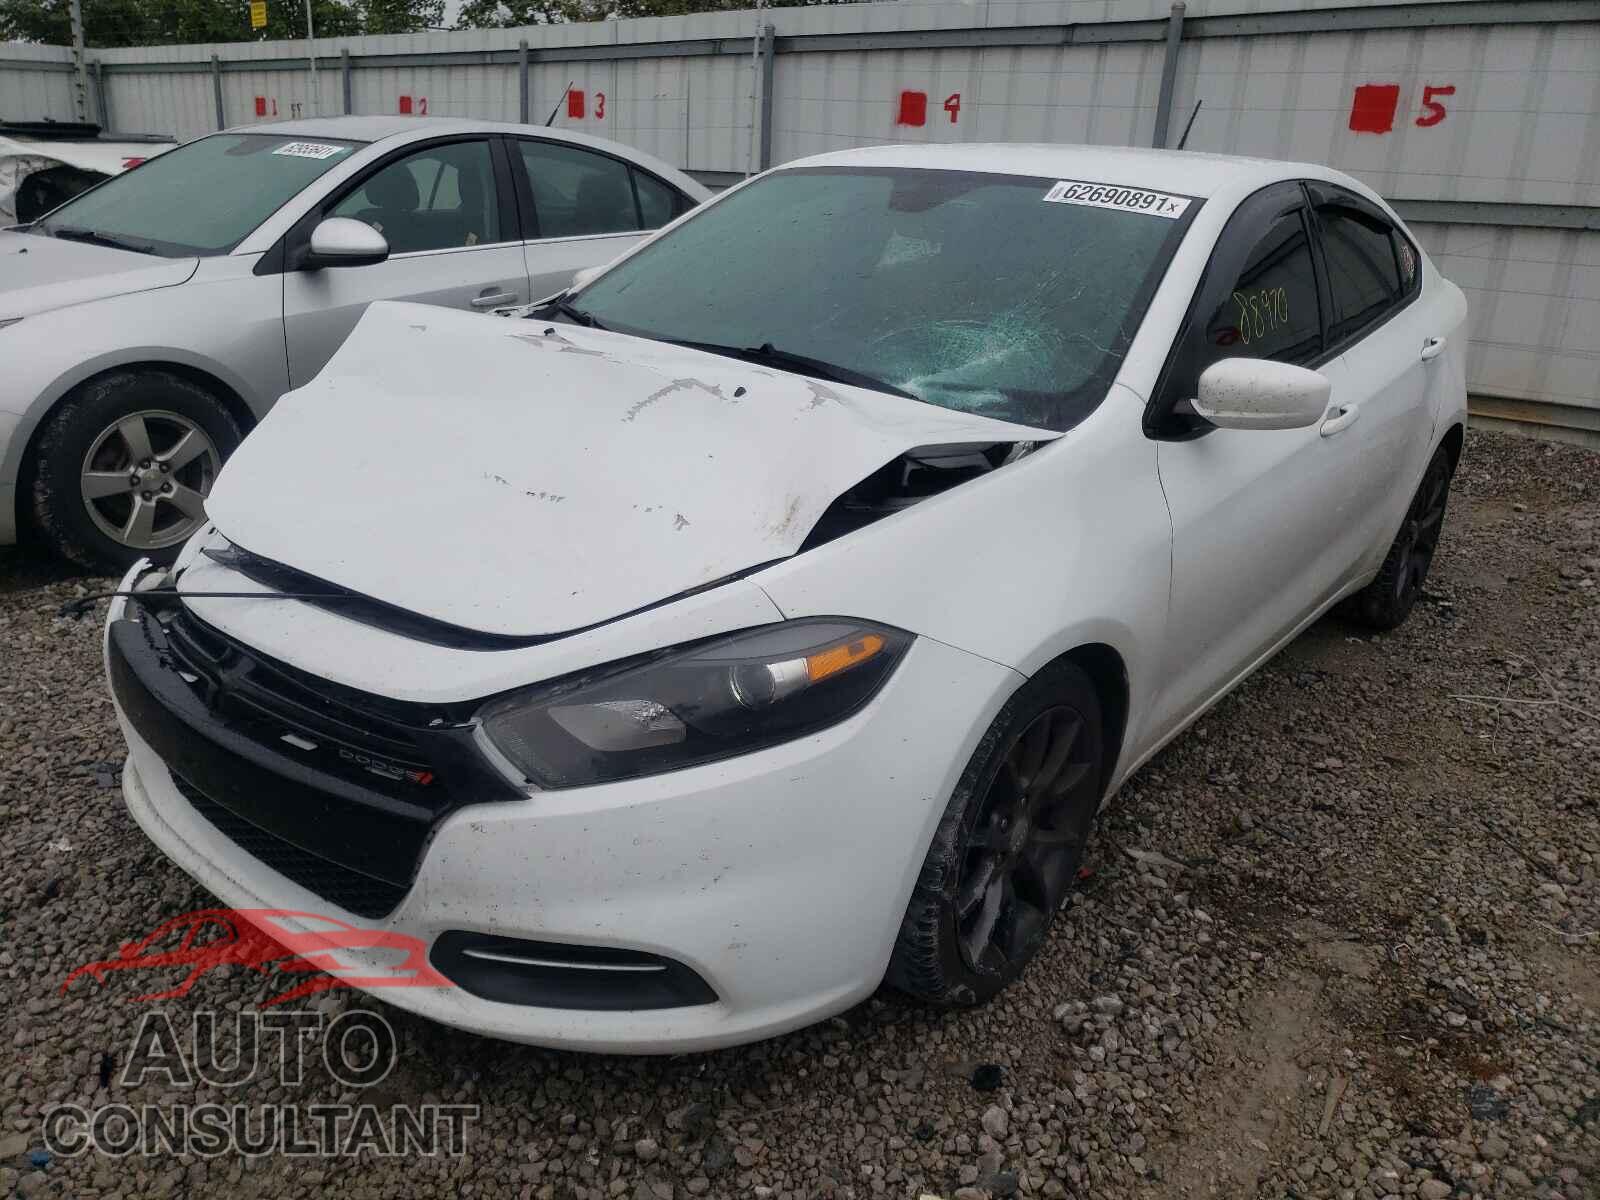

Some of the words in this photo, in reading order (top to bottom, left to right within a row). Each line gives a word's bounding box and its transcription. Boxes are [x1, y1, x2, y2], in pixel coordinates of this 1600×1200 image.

[271, 98, 278, 117] 1
[418, 97, 428, 115] 2
[594, 91, 606, 120] 3
[943, 93, 961, 124] 4
[1415, 85, 1456, 127] 5
